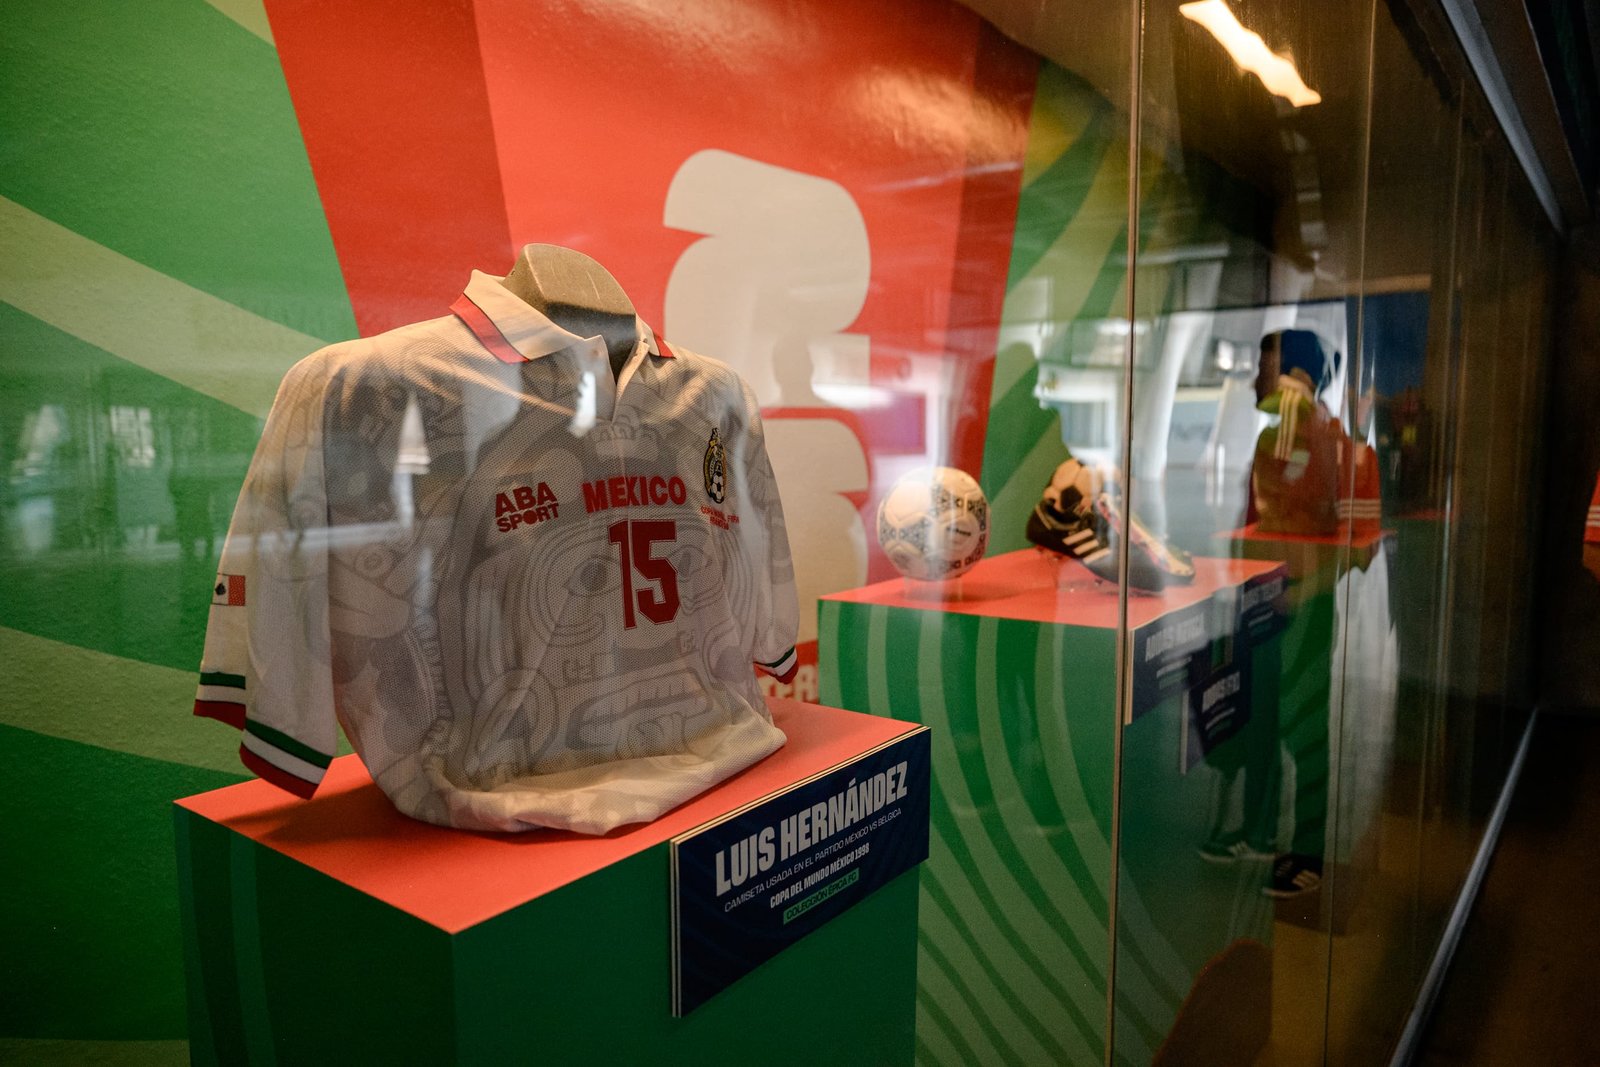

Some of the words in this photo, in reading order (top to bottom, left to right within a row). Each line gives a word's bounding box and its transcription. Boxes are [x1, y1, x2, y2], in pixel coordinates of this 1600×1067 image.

[495, 481, 558, 518] ABA
[496, 502, 559, 533] SPORT
[581, 475, 687, 513] MEXICO
[607, 519, 681, 630] 15
[715, 826, 775, 898] LUIS
[780, 760, 908, 861] HERNÁNDEZ
[724, 883, 764, 912] CAMISETA
[766, 867, 793, 888] USADA
[793, 861, 804, 874] EN
[805, 857, 814, 867] EL
[814, 840, 844, 861] PARTIDO
[869, 820, 878, 831] VS
[770, 887, 790, 909] COPA
[790, 880, 804, 897] DEL
[803, 865, 830, 890] MUNDO
[830, 851, 855, 875] MÉXICO
[855, 842, 870, 860] 1998
